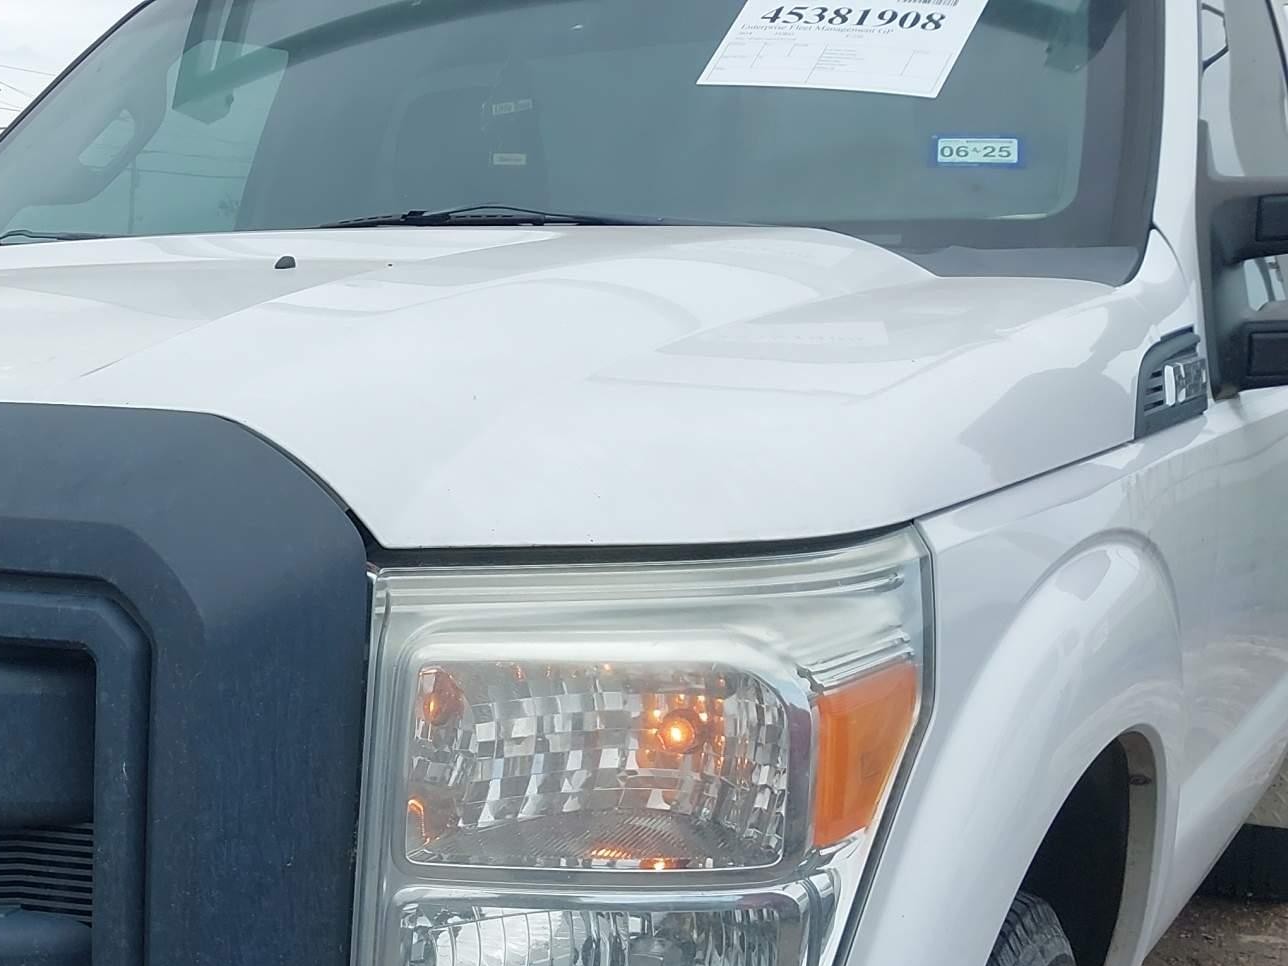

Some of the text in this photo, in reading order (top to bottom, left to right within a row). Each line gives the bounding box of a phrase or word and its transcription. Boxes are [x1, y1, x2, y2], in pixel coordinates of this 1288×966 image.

[760, 6, 946, 31] 45381908
[940, 145, 1012, 158] 06 25
